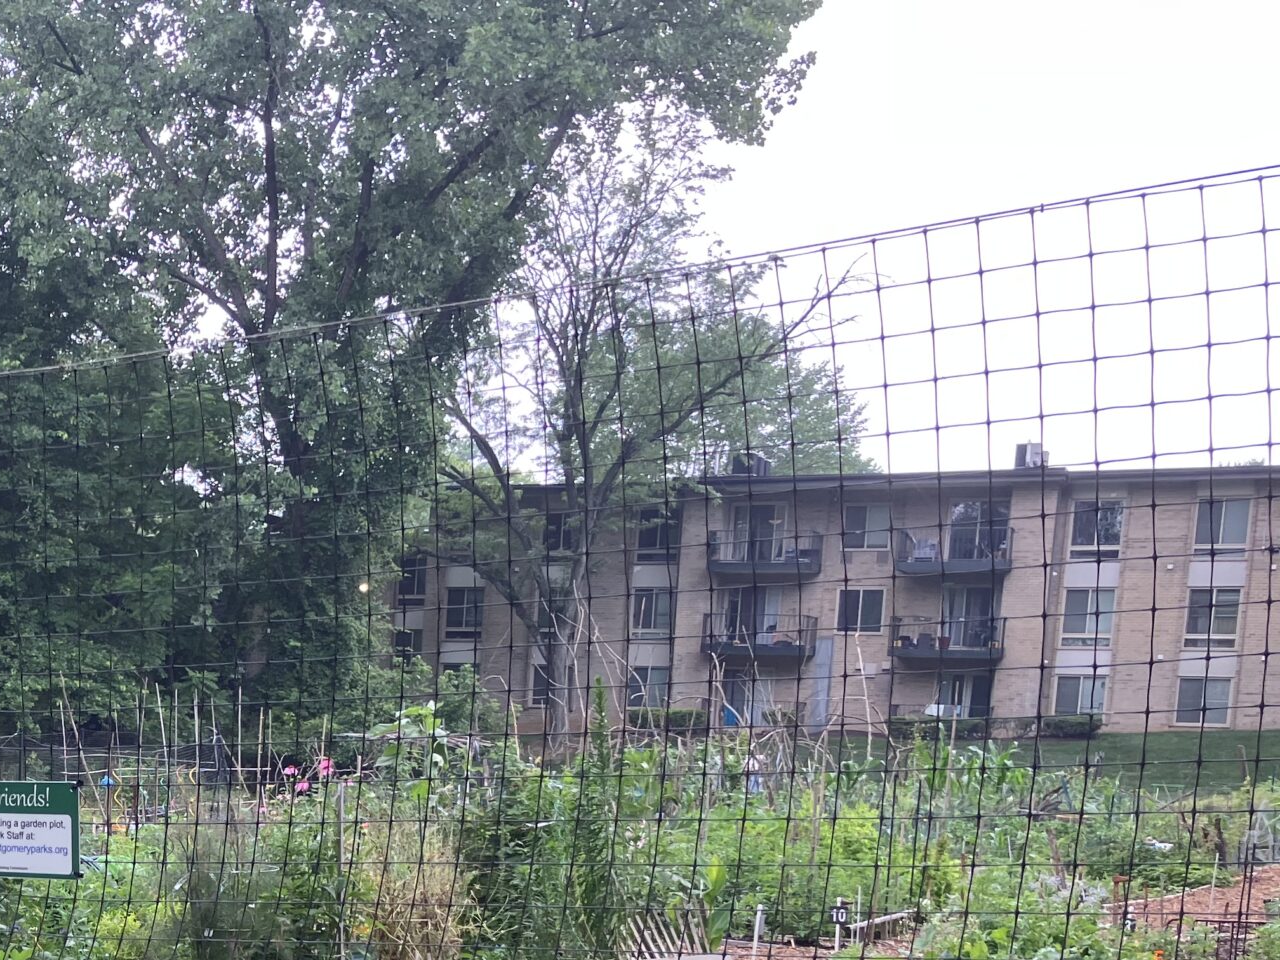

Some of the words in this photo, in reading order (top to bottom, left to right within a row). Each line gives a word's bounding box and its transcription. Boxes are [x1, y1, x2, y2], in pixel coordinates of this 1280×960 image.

[13, 820, 19, 828] a
[20, 819, 48, 830] garden
[49, 819, 66, 830] plot,
[6, 830, 24, 840] Staff
[830, 908, 847, 922] 10
